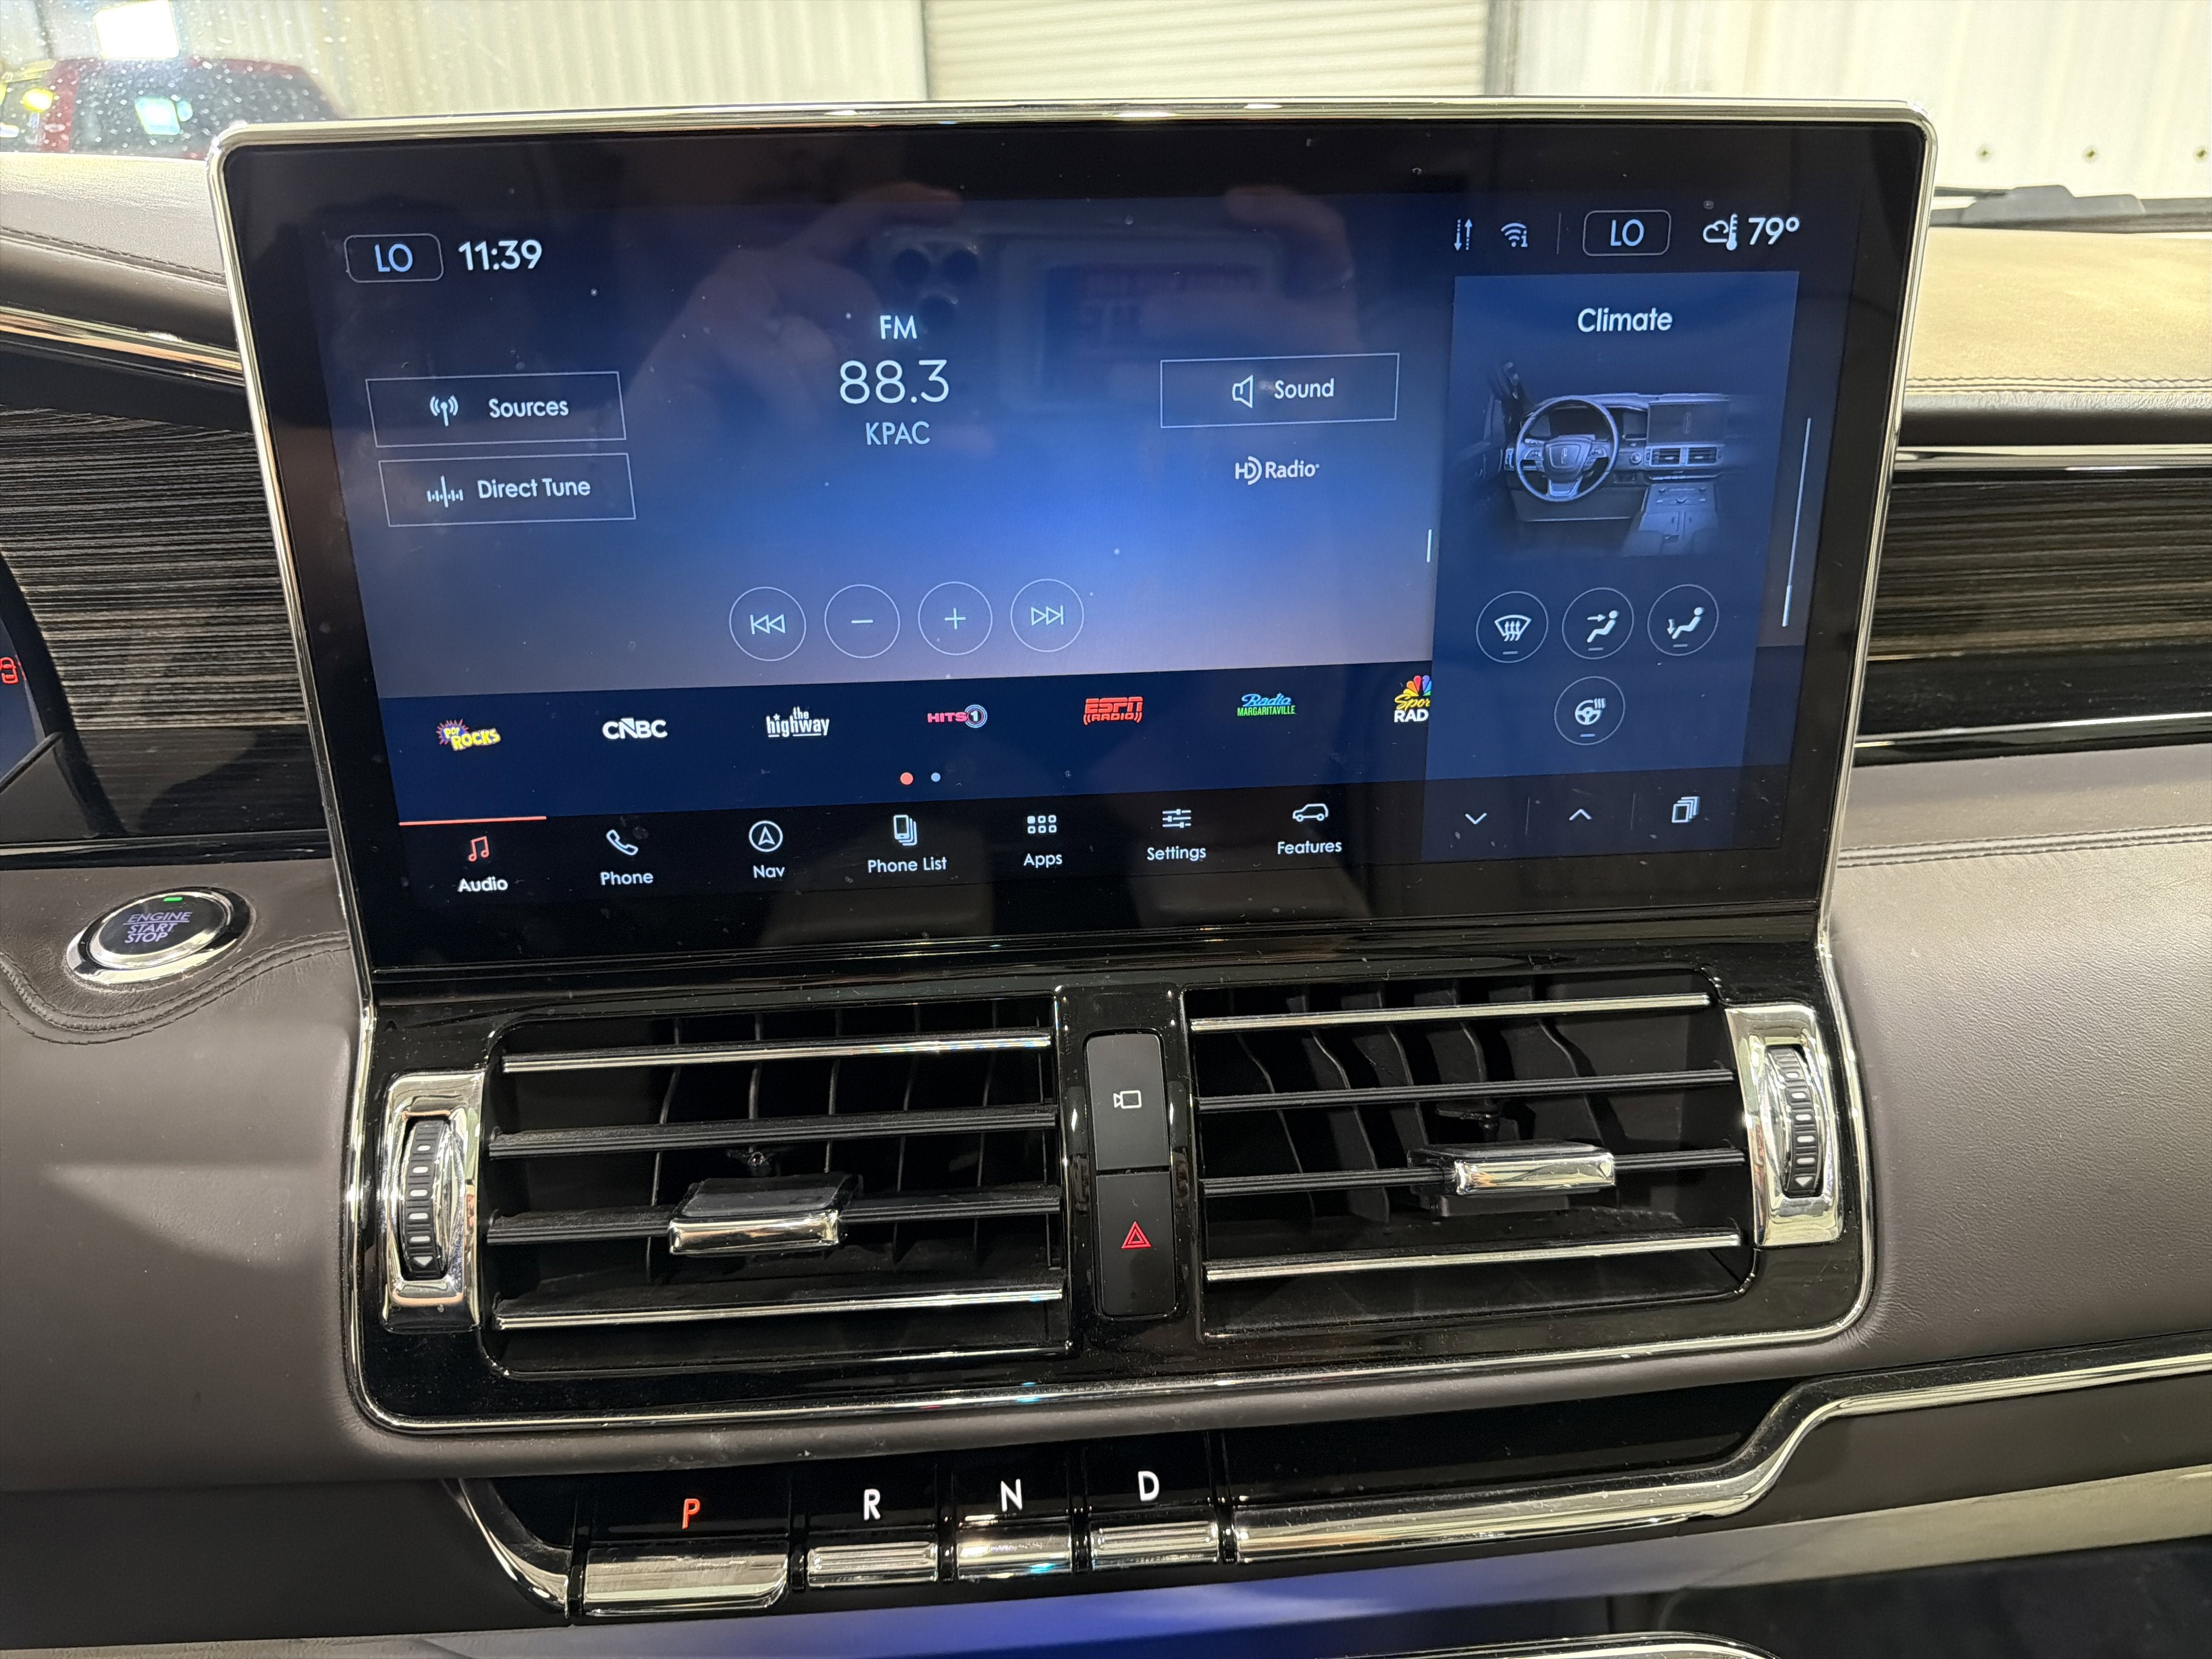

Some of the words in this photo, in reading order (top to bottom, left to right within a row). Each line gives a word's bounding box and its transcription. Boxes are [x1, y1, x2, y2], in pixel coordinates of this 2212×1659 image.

[1610, 219, 1644, 246] LO
[374, 244, 413, 272] LO
[458, 239, 542, 270] 11:39
[880, 315, 917, 340] FM
[1578, 307, 1673, 332] Climate
[840, 359, 949, 404] 88.3
[1274, 378, 1334, 399] Sound
[489, 398, 569, 418] Sources
[866, 421, 930, 445] KPAC
[1265, 459, 1317, 479] Radio
[477, 478, 538, 499] Direct
[541, 478, 591, 496] Tune
[1085, 696, 1143, 714] ESPN
[1242, 693, 1291, 707] Radio
[793, 706, 809, 720] the
[927, 712, 967, 723] HITS
[1237, 705, 1296, 716] MARGARITAVILLE
[444, 727, 460, 739] POP
[602, 717, 668, 740] CNBC
[766, 713, 830, 737] highway
[451, 727, 501, 751] ROCKS
[1147, 845, 1206, 861] Settings
[1277, 840, 1342, 855] Features
[868, 859, 918, 873] Phone
[923, 856, 947, 871] List
[1023, 853, 1063, 868] Apps
[600, 871, 654, 885] Phone
[753, 865, 785, 878] Nav
[458, 876, 509, 893] Audio
[127, 911, 193, 921] ENGINE
[124, 932, 169, 944] STOP
[127, 923, 179, 934] START
[1001, 1479, 1023, 1512] N
[1138, 1471, 1160, 1502] D
[682, 1498, 701, 1530] P
[864, 1488, 881, 1520] R
